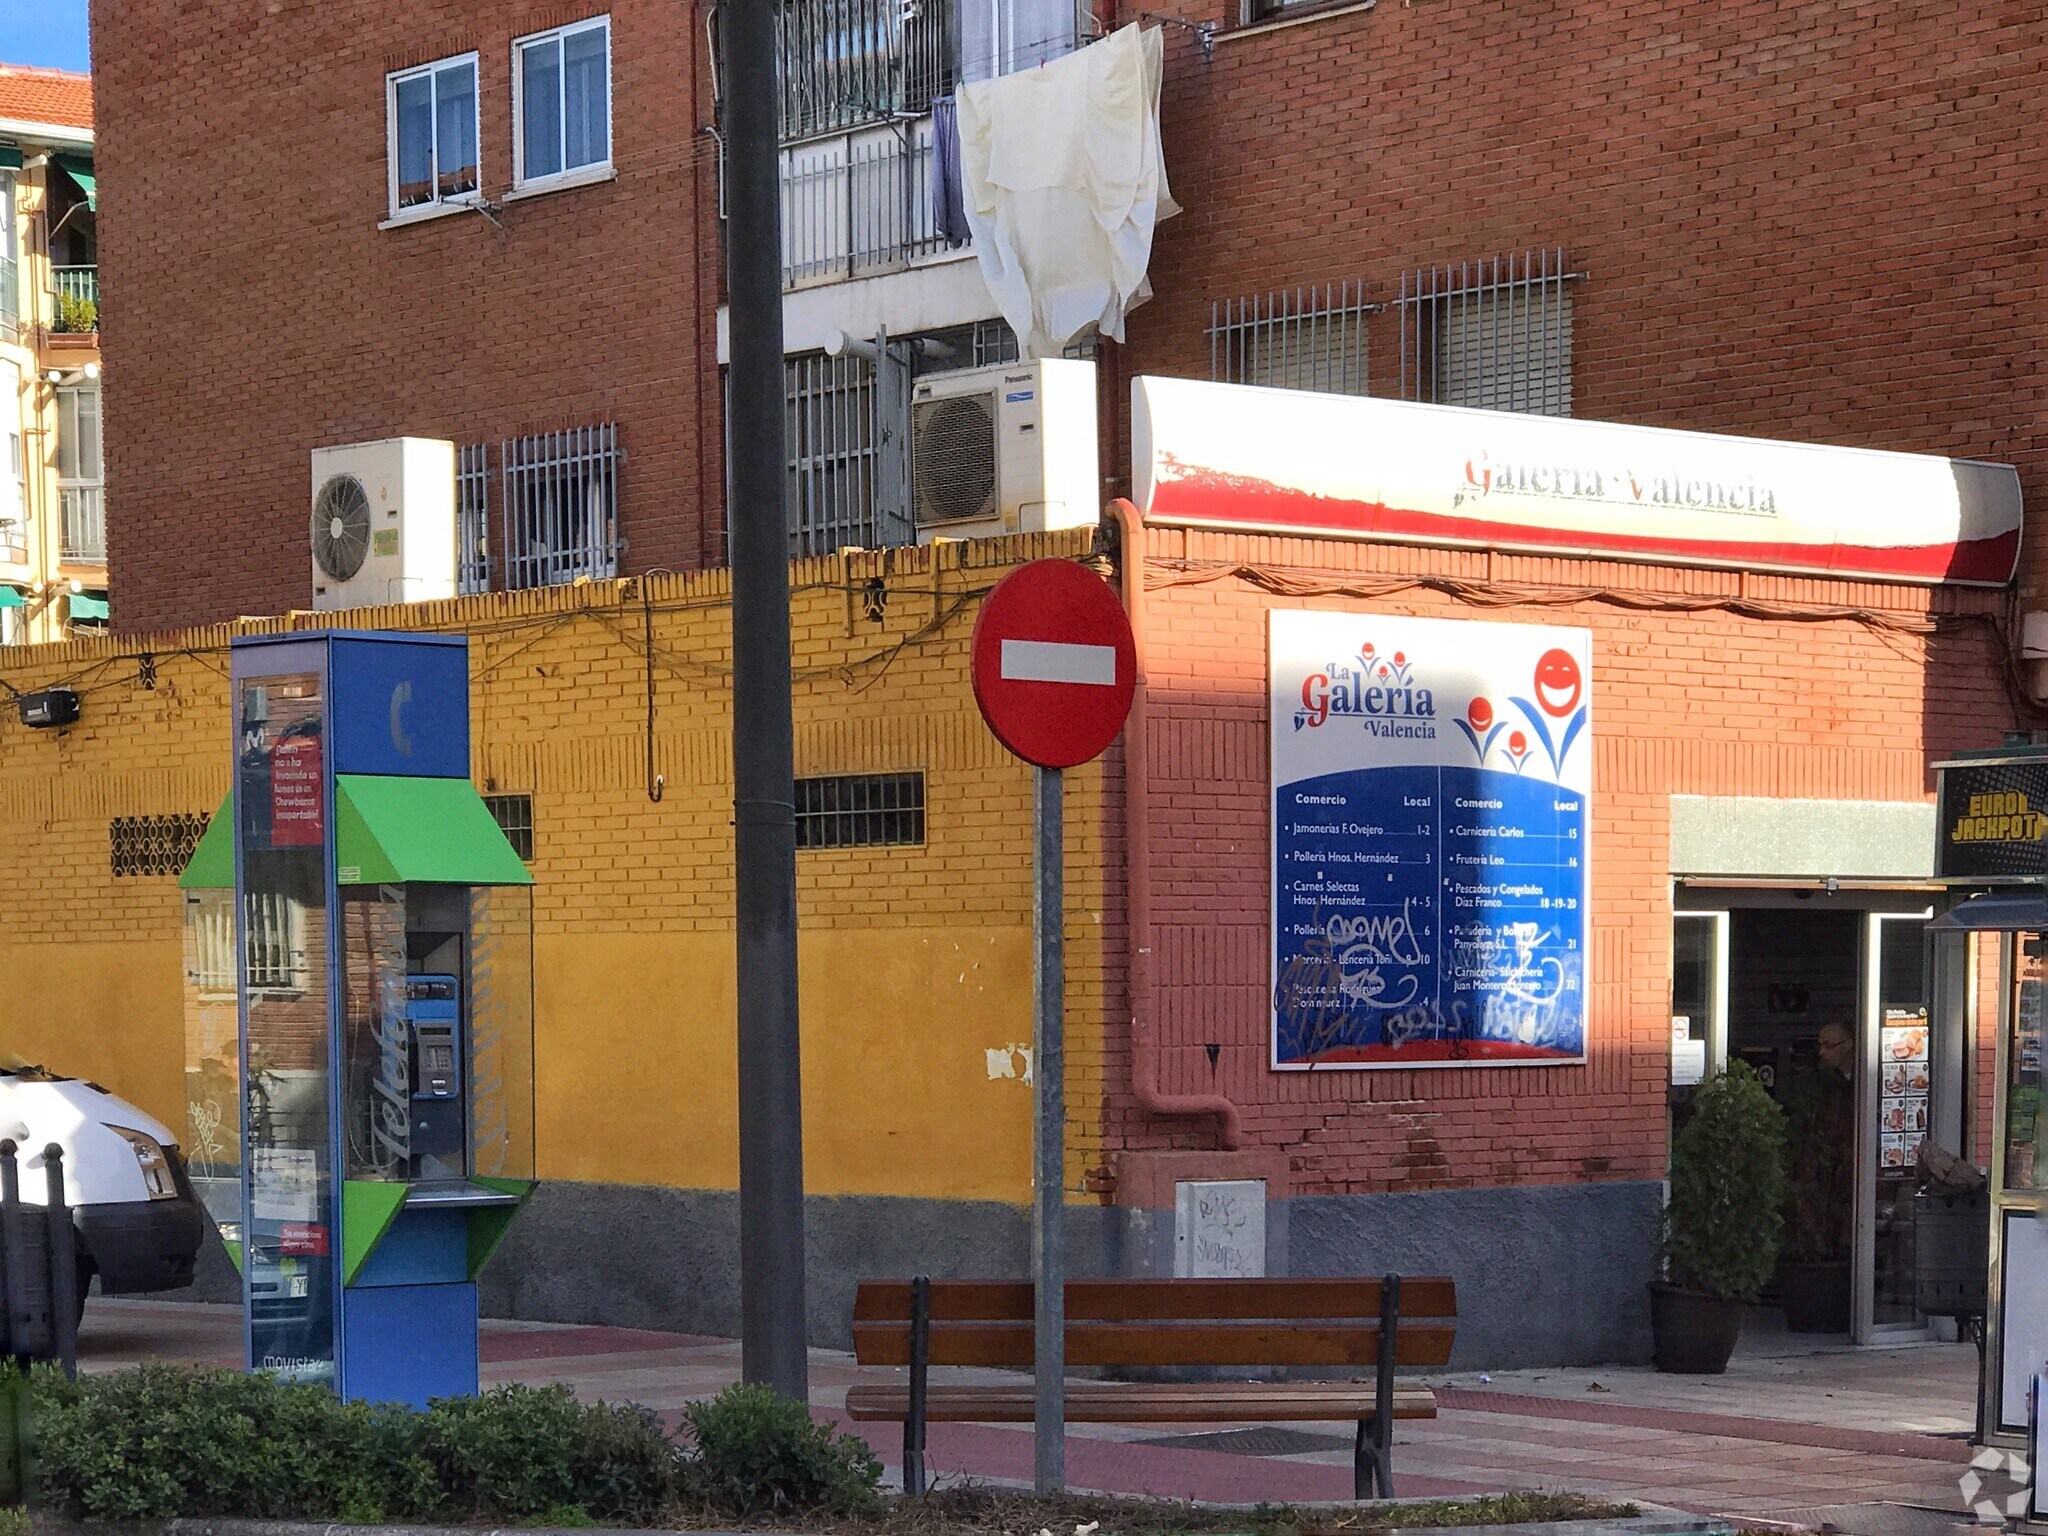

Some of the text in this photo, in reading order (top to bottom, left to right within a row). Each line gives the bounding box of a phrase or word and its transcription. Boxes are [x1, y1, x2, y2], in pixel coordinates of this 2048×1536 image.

[1326, 662, 1350, 680] La
[1302, 671, 1436, 728] Galería
[1364, 720, 1436, 739] Valencia
[1295, 793, 1431, 807] Comercio Local
[1455, 797, 1578, 811] Comercio Local
[1969, 790, 2020, 817] EURO
[1417, 824, 1431, 836] 1-2
[1455, 825, 1578, 839] Carnicería Carlos 15
[1951, 814, 2037, 842] JACKPOT
[1294, 850, 1431, 864] Pollería Hnos. Hernández 3
[1456, 853, 1578, 868] Frutería Leo 16
[1293, 880, 1360, 892] Carnes Selectas
[1455, 883, 1544, 898] Pescados y Congelados
[1320, 894, 1366, 906] Hernández
[1475, 897, 1503, 908] Franco
[1567, 898, 1577, 909] 20
[1424, 926, 1430, 936] 6
[1568, 939, 1577, 949] 21
[1453, 980, 1471, 993] Juan
[1472, 980, 1506, 991] Montero
[1566, 980, 1576, 990] 32
[263, 1355, 324, 1372] movistar
